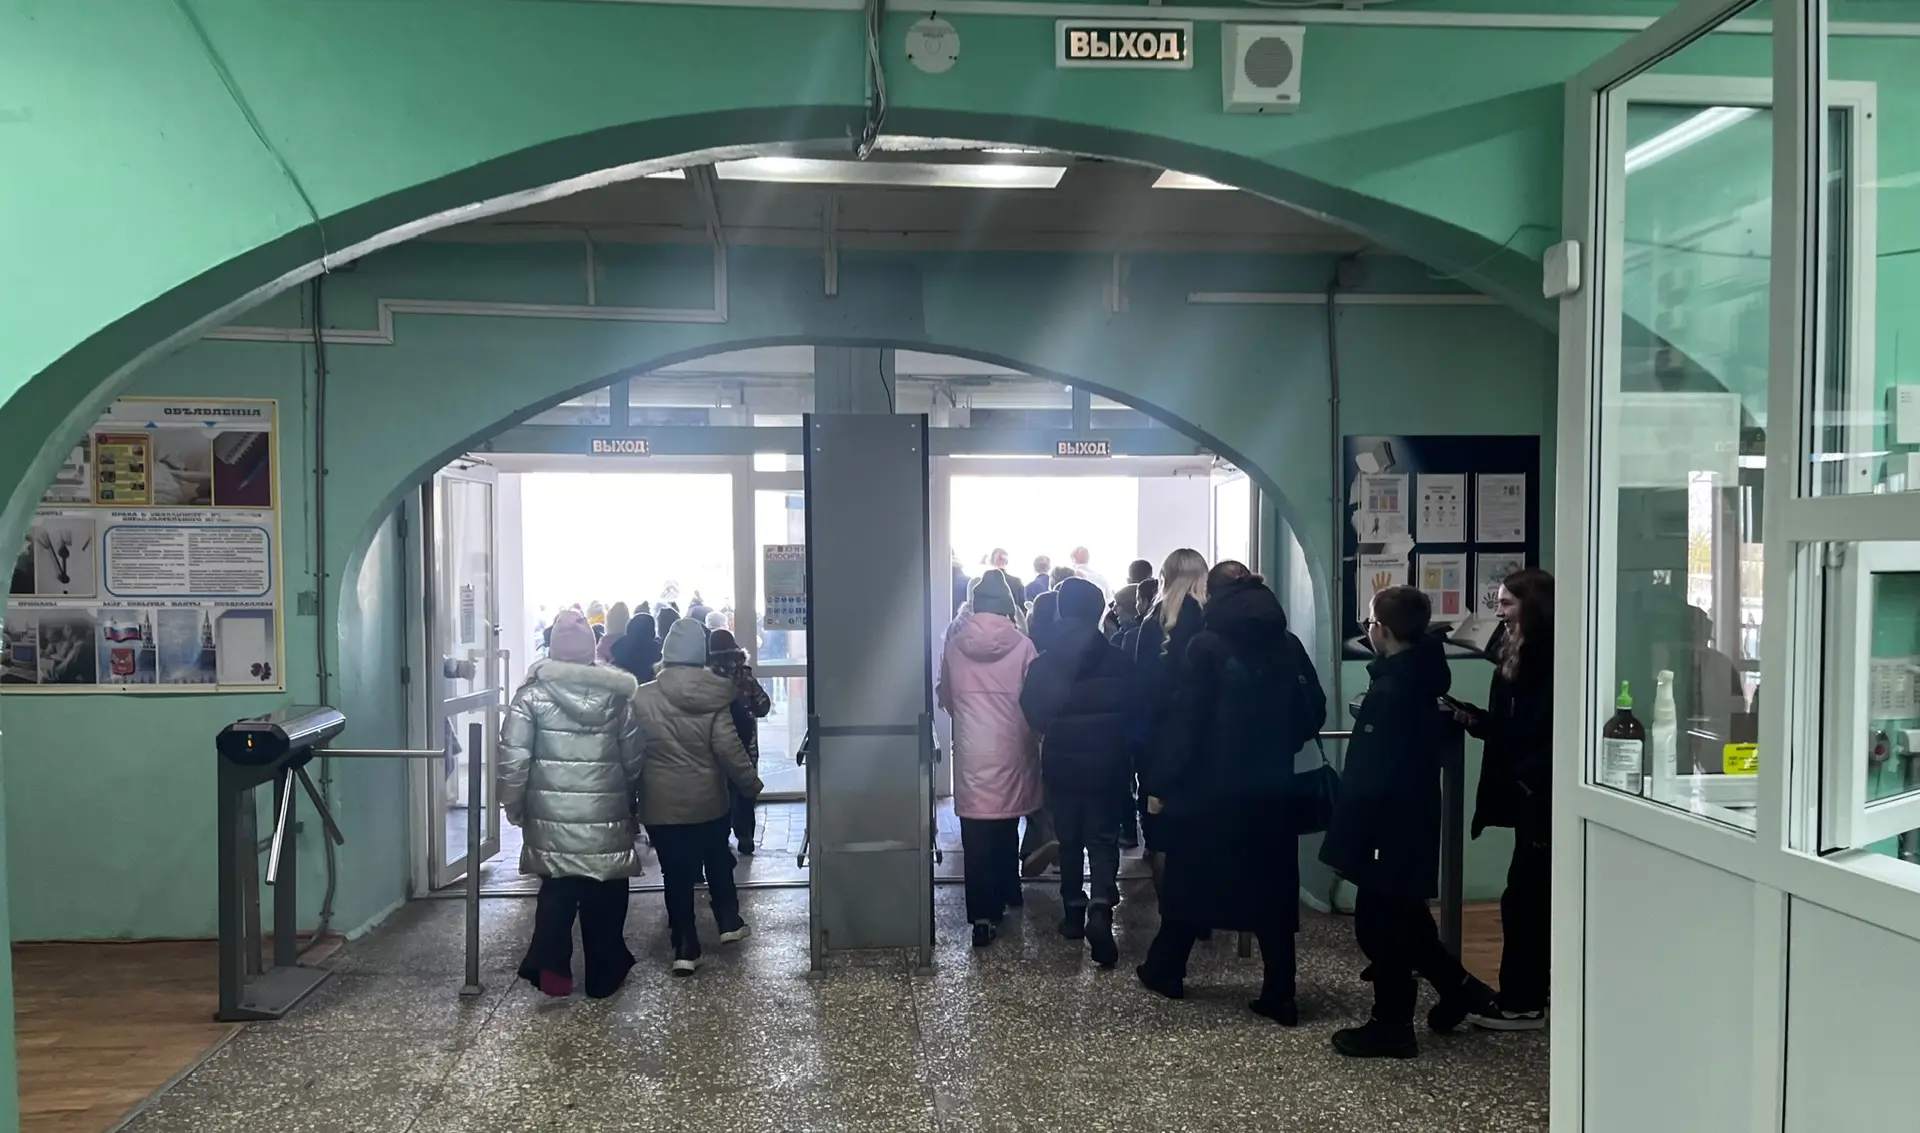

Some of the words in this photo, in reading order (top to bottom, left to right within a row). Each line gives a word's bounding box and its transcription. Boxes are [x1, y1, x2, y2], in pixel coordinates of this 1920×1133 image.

[1070, 31, 1179, 59] ВЫХОД
[163, 406, 262, 417] ОБЪЯВЛЕНИЯ
[593, 439, 645, 453] ВЫХОД
[1058, 442, 1107, 455] ВЫХОД
